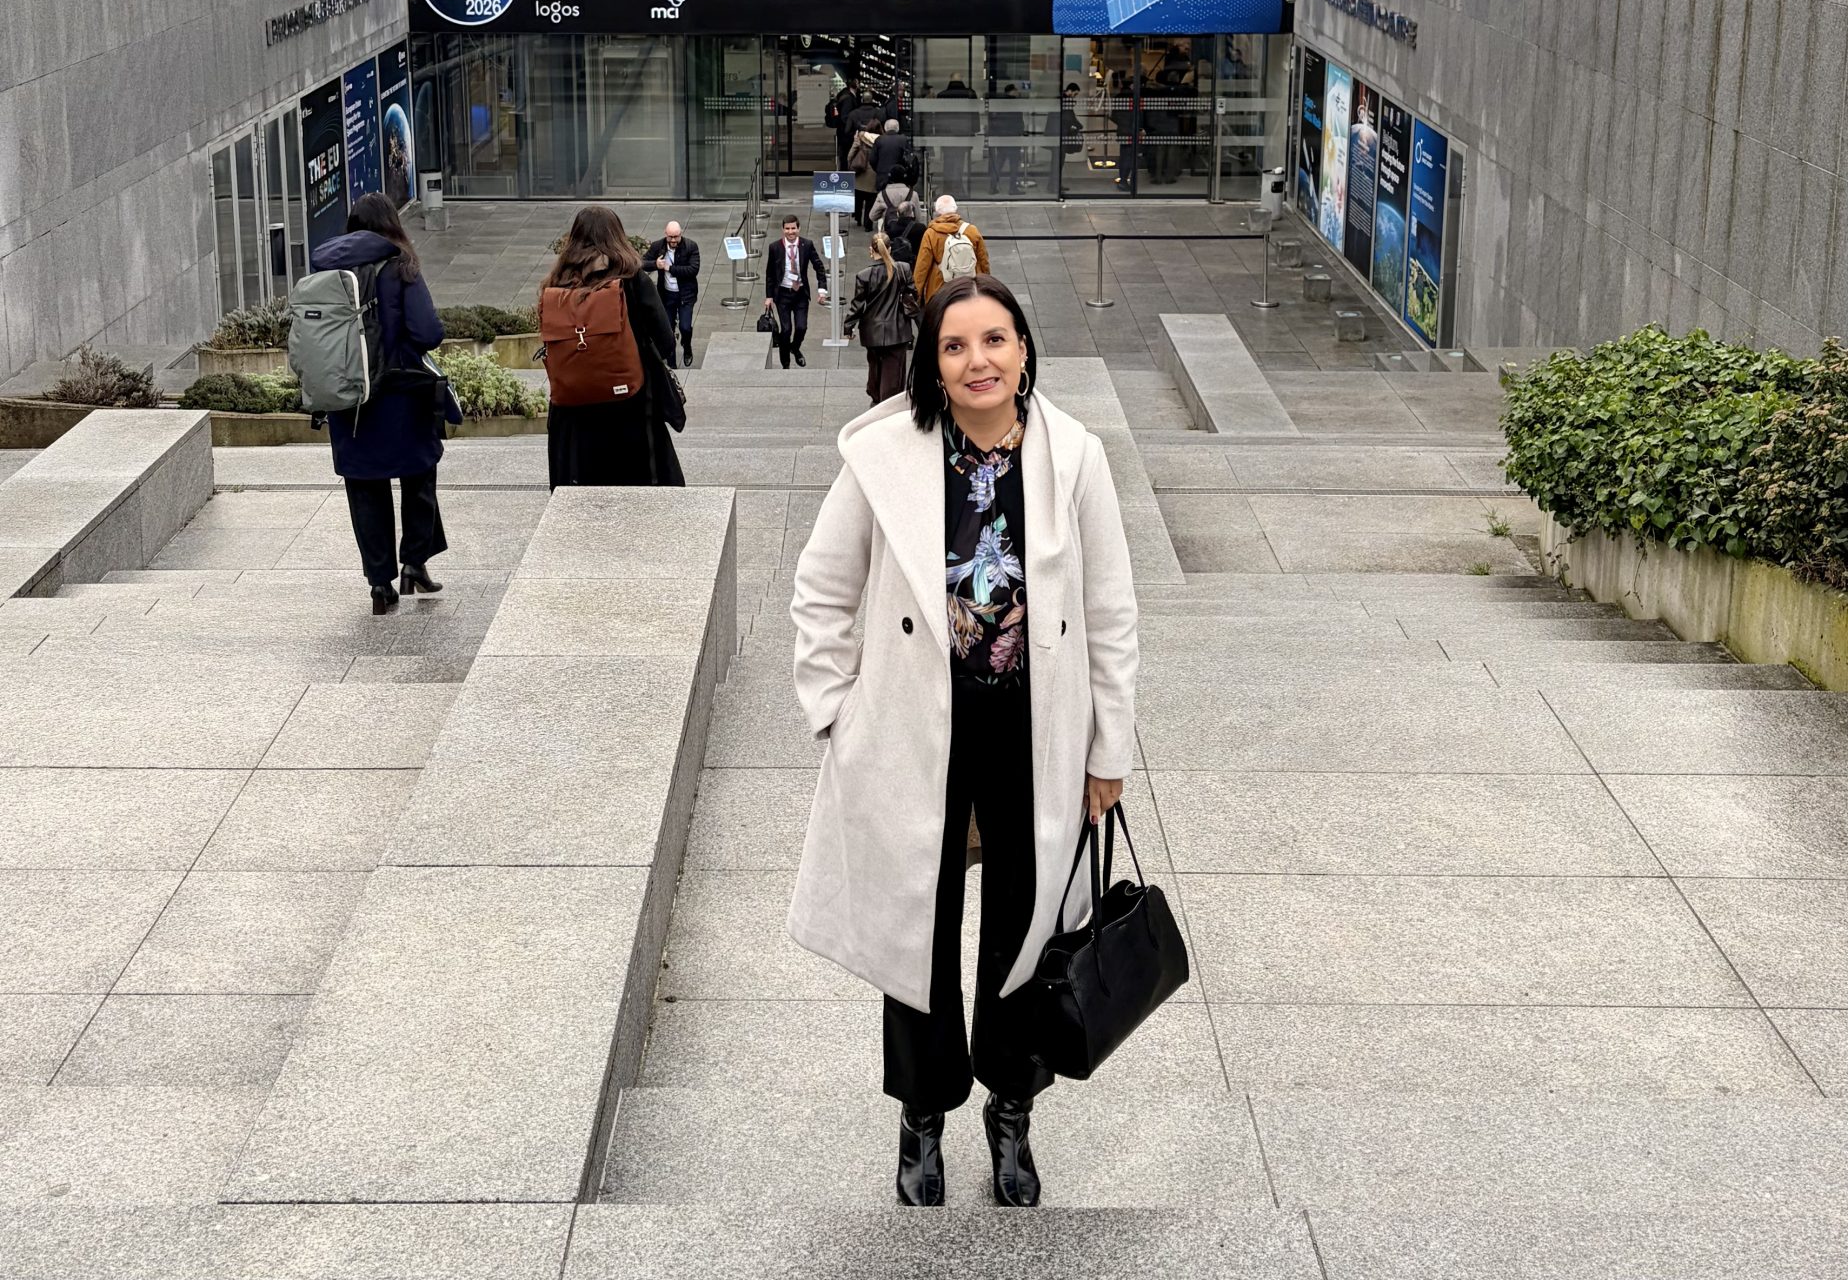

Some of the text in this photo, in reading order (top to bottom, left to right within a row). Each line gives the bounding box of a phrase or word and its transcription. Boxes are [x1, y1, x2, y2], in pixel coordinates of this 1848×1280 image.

[465, 0, 502, 17] 2026
[535, 0, 580, 24] logos
[651, 6, 680, 19] mci
[308, 150, 327, 185] THE
[327, 142, 340, 172] EU
[319, 170, 341, 203] SPACE
